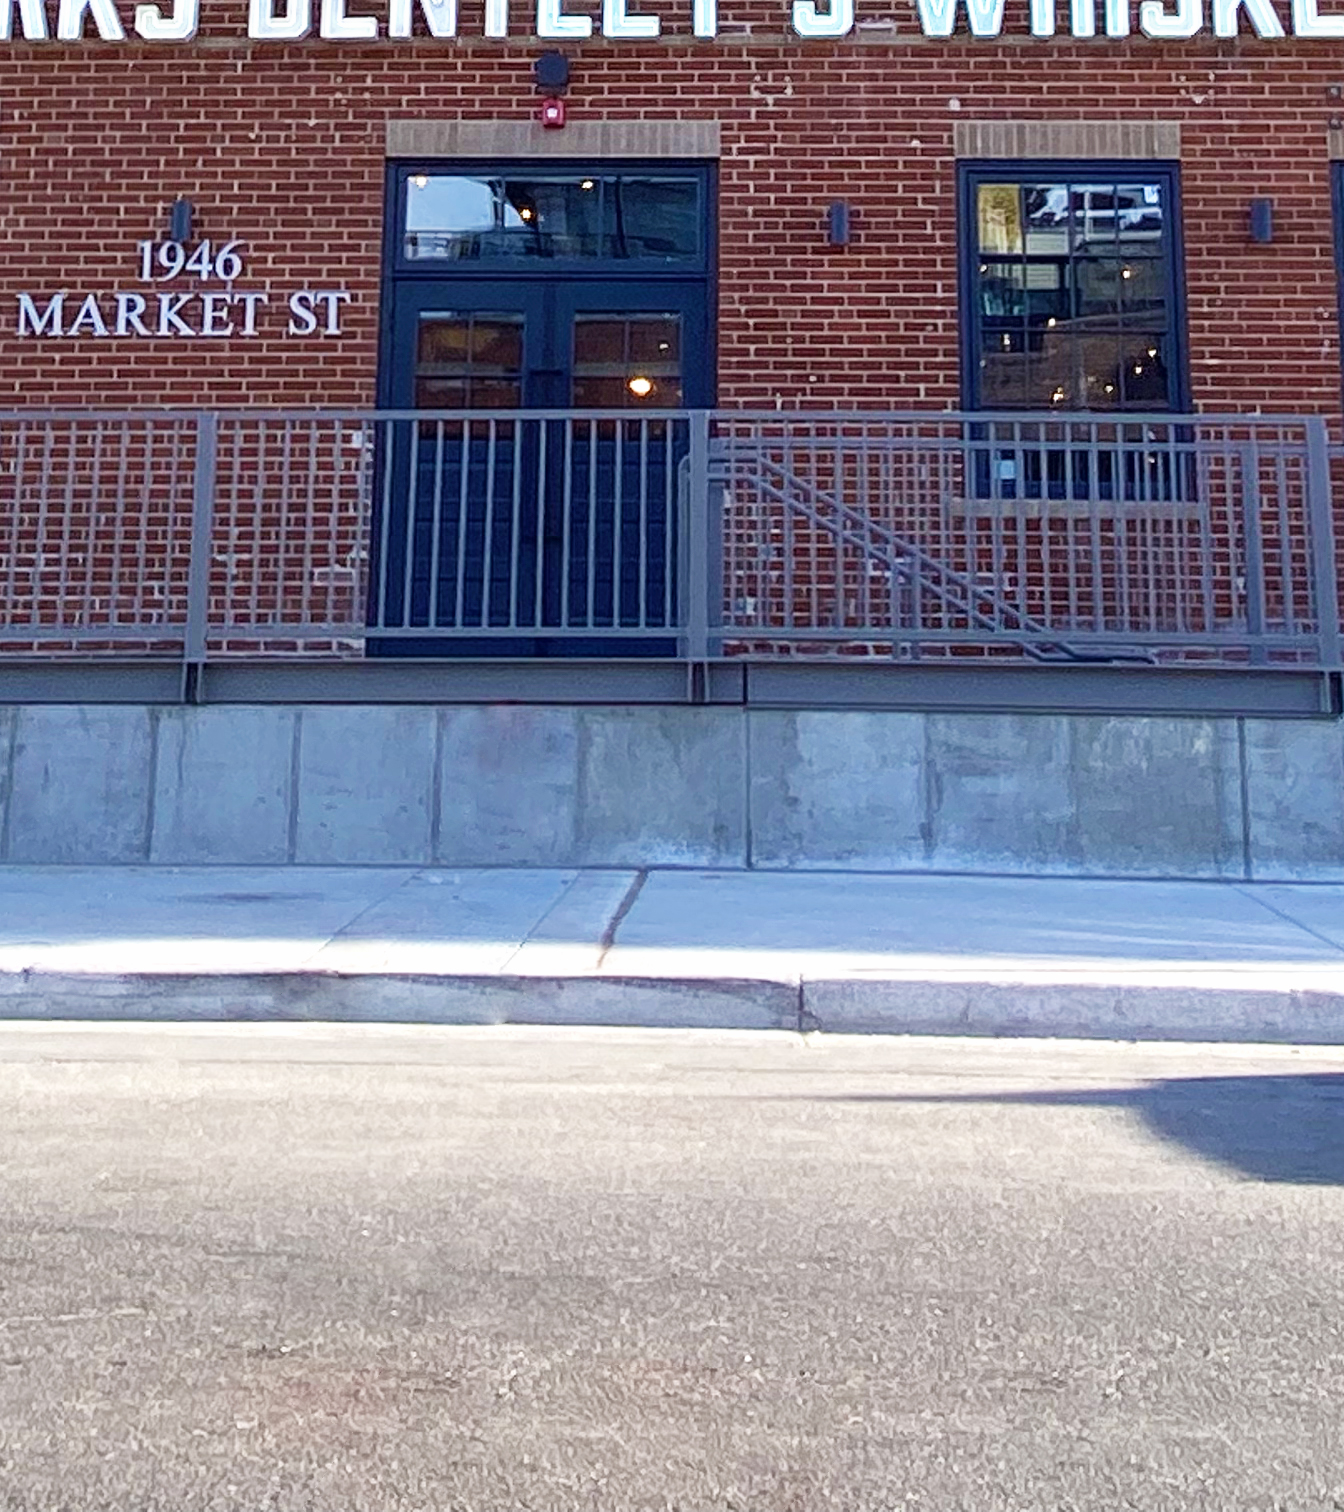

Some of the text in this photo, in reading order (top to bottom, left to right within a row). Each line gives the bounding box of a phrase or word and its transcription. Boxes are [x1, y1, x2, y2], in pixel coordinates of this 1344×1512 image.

[136, 237, 246, 283] 1946
[14, 290, 351, 339] MARKET ST
